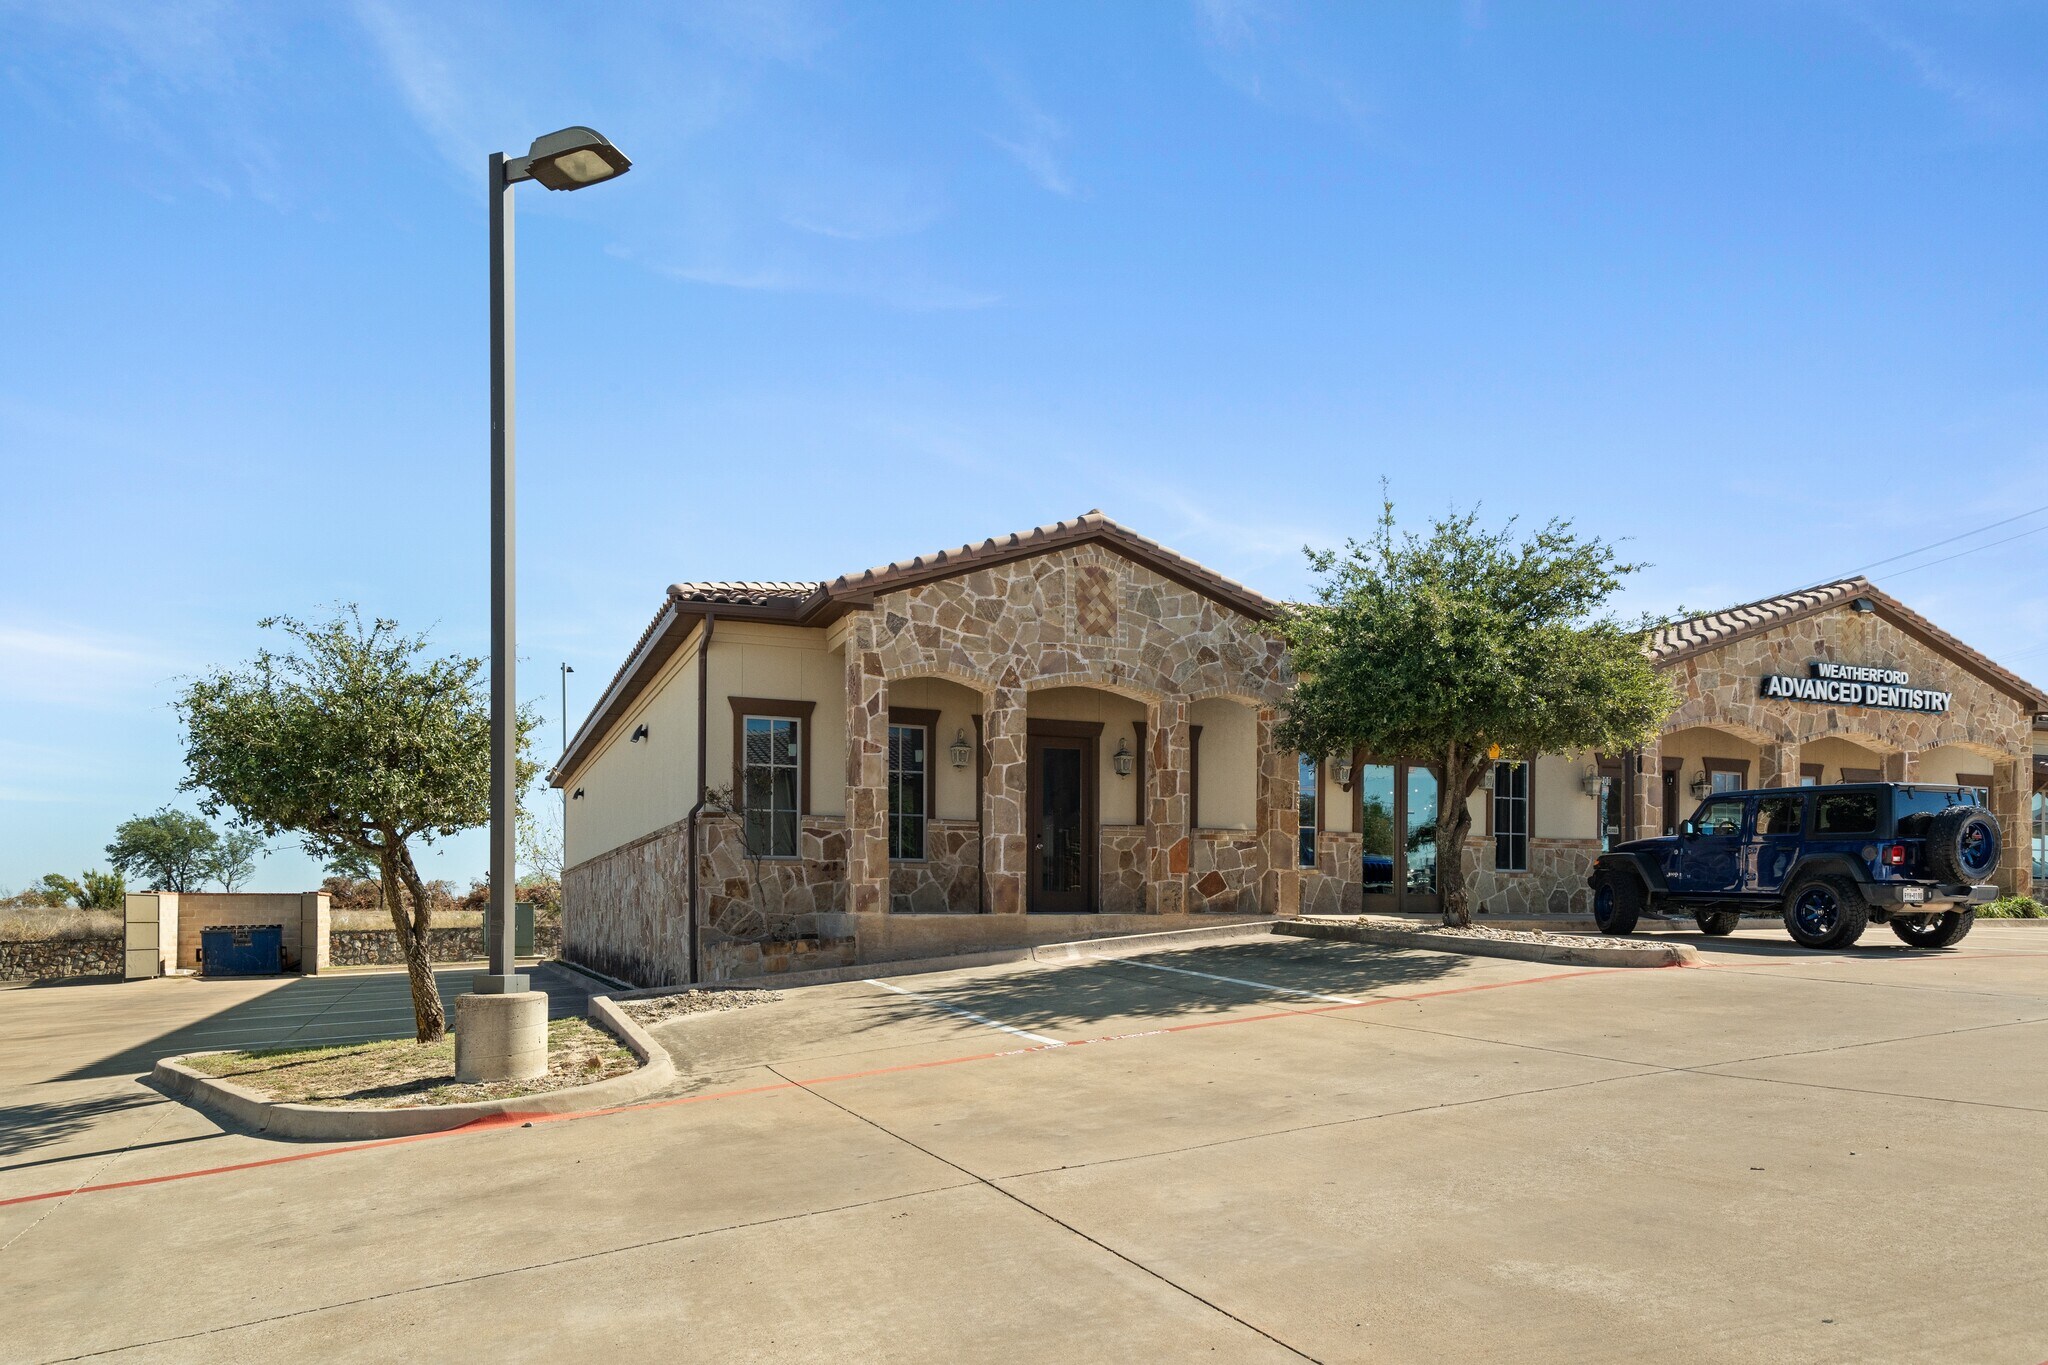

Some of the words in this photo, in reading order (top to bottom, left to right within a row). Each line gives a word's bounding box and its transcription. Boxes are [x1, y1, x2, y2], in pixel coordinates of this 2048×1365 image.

[1818, 663, 1909, 684] WEATHERFORD
[1767, 675, 1862, 703] ADVANCED
[1865, 685, 1952, 711] DENTISTRY
